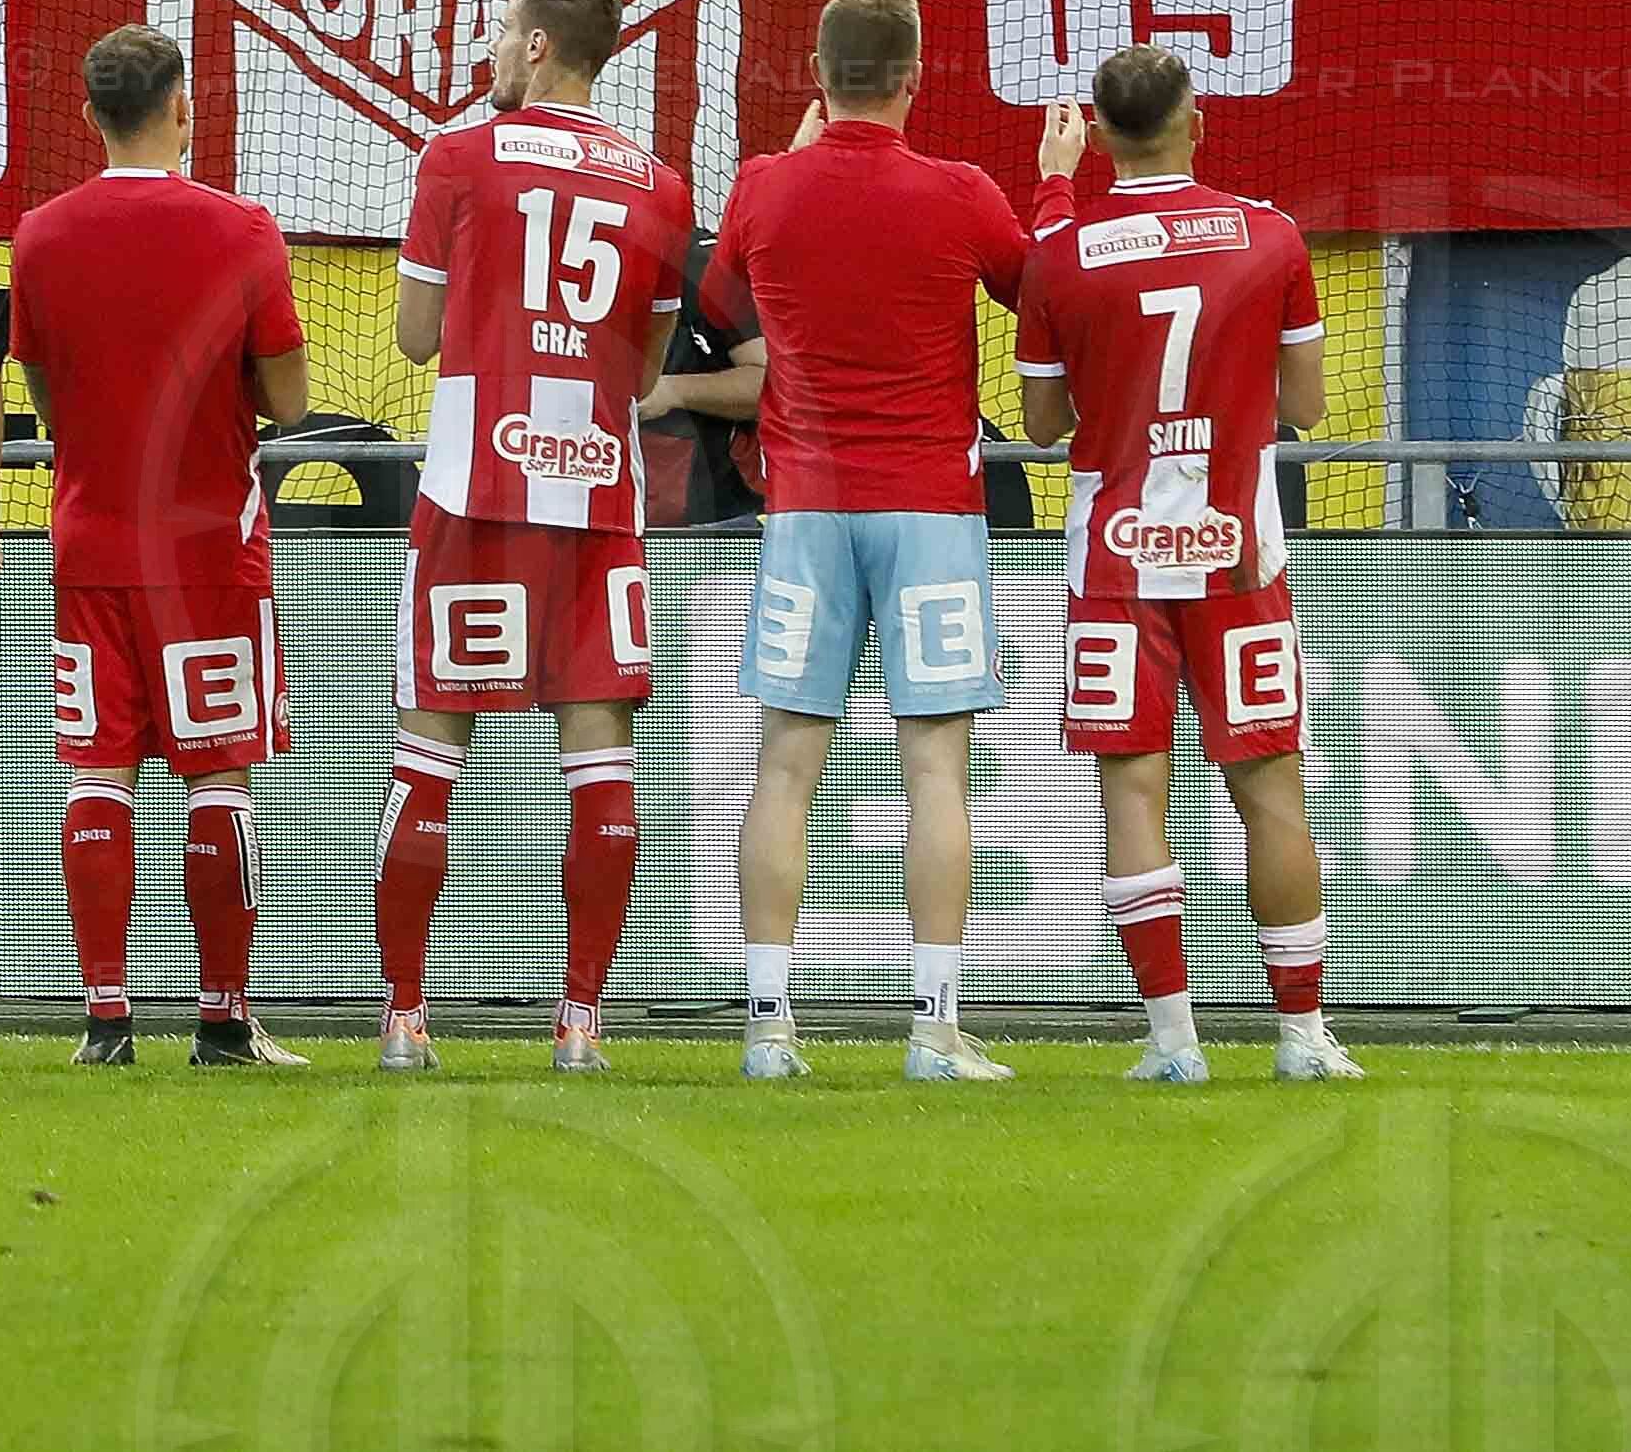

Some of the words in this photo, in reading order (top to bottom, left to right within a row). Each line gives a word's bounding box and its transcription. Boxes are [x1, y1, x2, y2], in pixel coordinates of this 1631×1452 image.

[499, 138, 578, 162] SORGER
[517, 188, 629, 323] 15
[1085, 233, 1161, 258] SORGER
[1173, 215, 1245, 239] SALANETTIS
[1138, 285, 1202, 413] 7
[1149, 417, 1212, 455] SATIN
